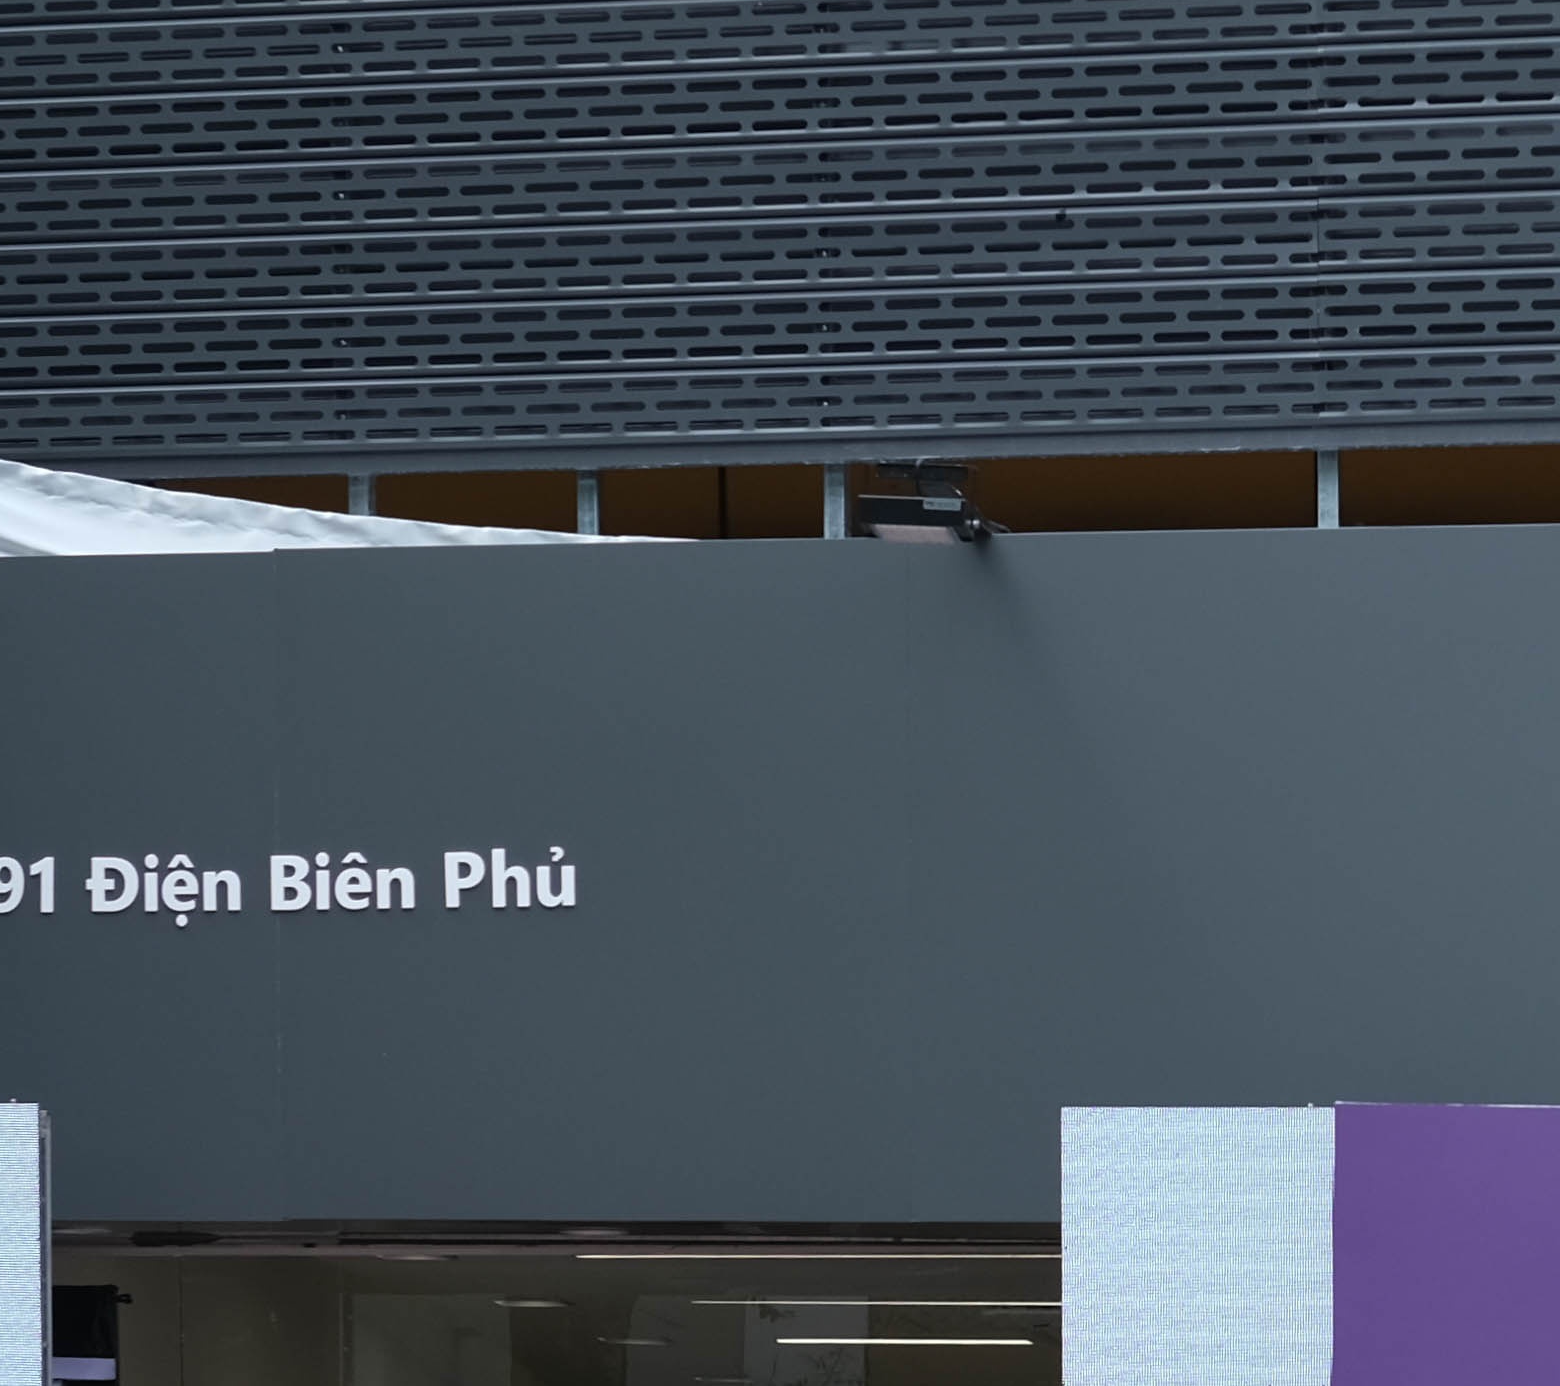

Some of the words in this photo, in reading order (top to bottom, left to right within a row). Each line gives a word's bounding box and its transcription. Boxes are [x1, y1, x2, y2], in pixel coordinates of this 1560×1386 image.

[85, 853, 242, 928] Điện
[269, 850, 416, 912] Biên
[443, 845, 578, 911] Phủ
